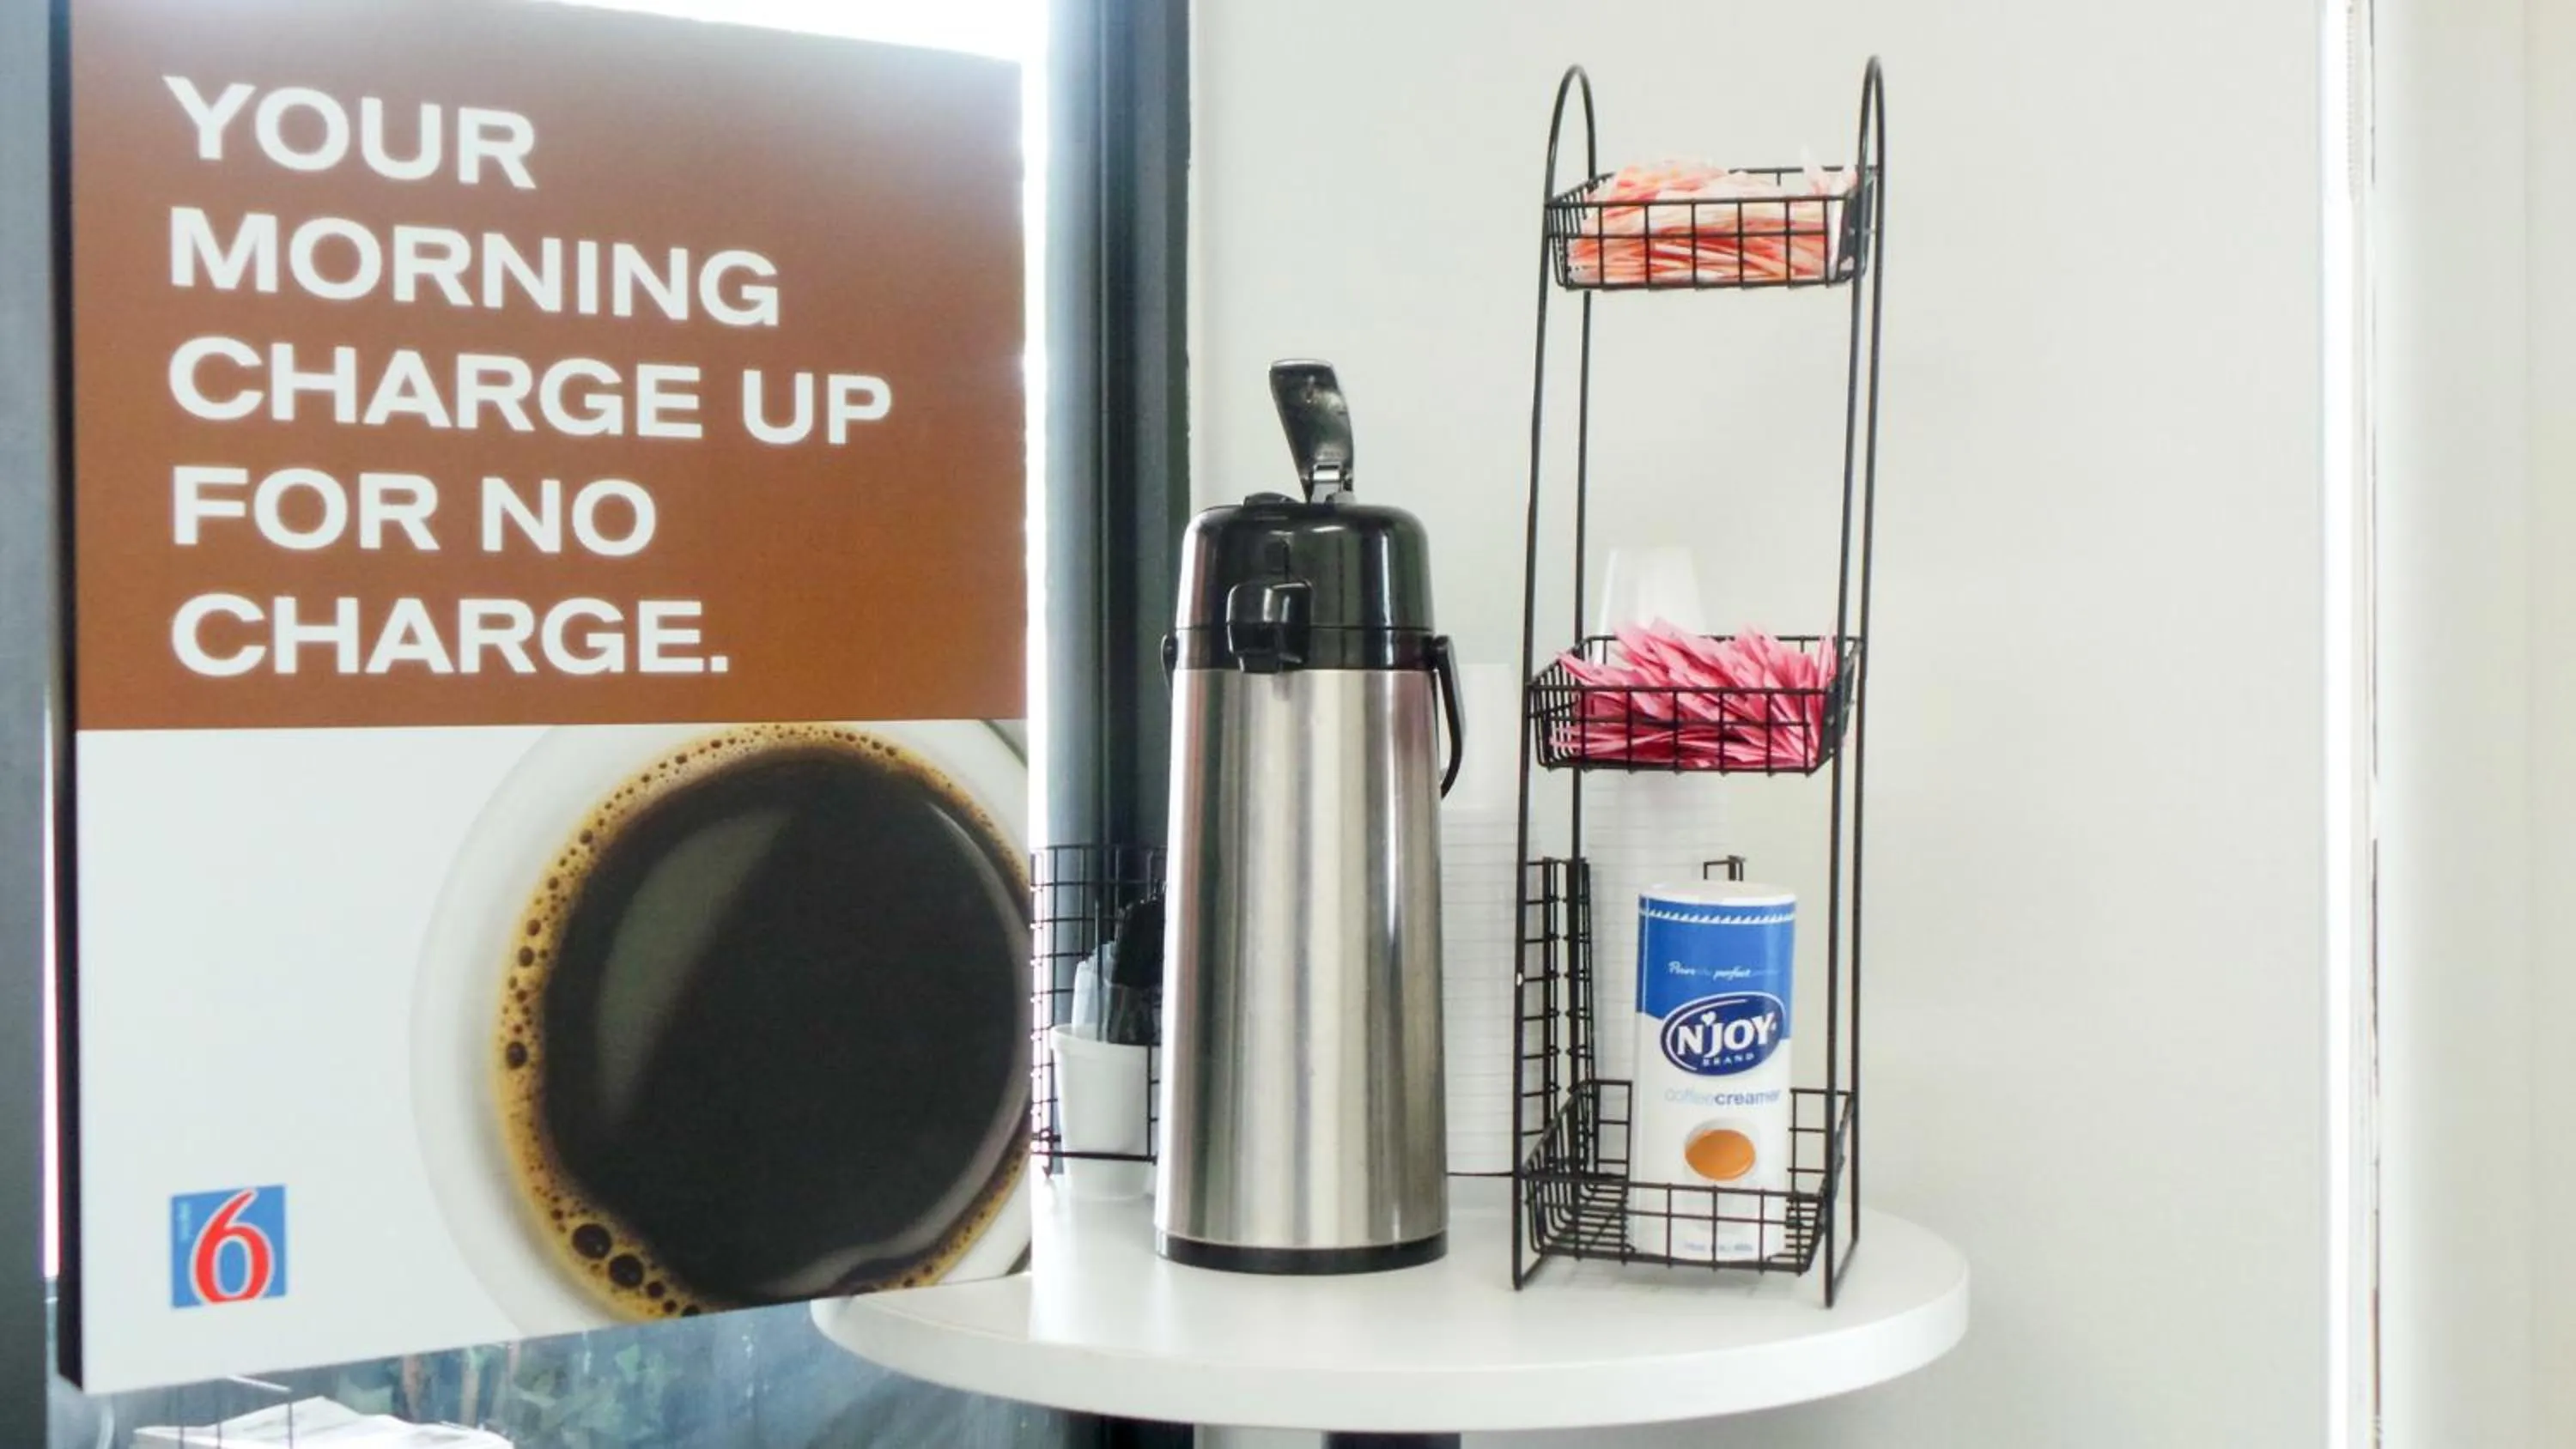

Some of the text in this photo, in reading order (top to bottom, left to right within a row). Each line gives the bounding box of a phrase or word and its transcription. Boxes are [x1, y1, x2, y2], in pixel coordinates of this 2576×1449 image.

[162, 74, 538, 191] YOUR
[168, 204, 781, 328] MORNING
[167, 335, 892, 446] CHARGE UP
[172, 464, 657, 558] FOR NO
[170, 591, 729, 678] CHARGE.
[1702, 1052, 1755, 1067] BRAND
[189, 1187, 275, 1304] 6
